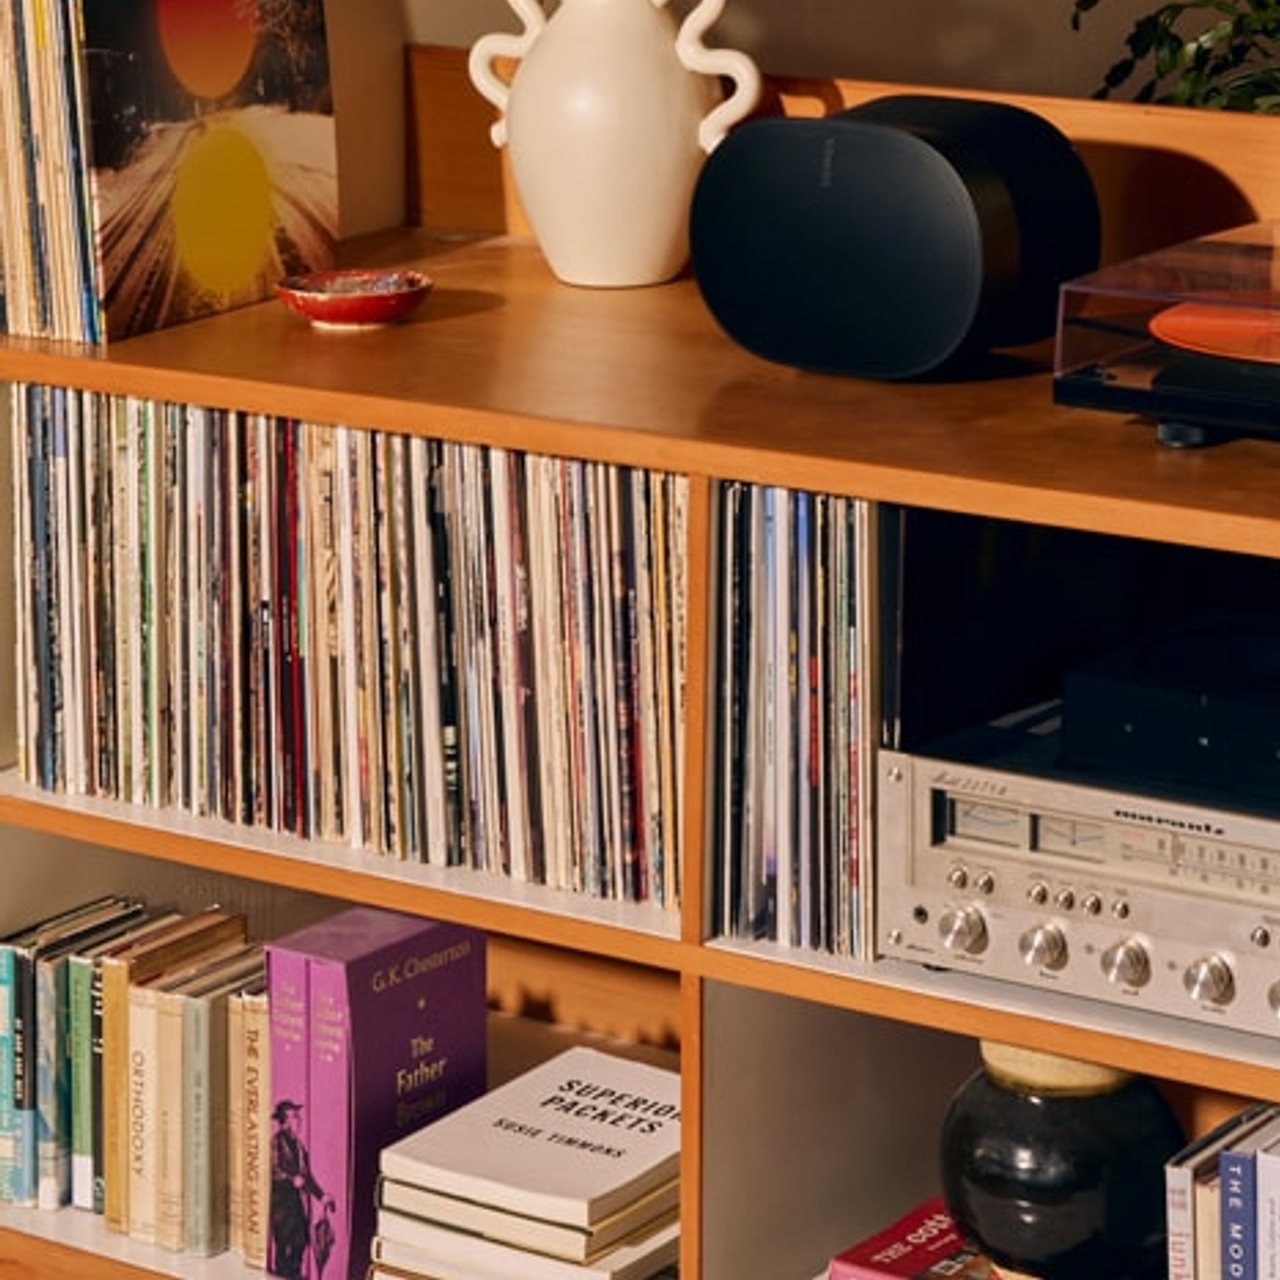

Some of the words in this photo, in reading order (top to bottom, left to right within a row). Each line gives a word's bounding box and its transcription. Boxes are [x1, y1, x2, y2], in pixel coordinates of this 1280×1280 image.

[403, 941, 472, 979] Chesterton
[246, 1028, 260, 1060] THE
[410, 1035, 436, 1060] The
[396, 1058, 448, 1097] Father
[131, 1050, 146, 1177] ORTHODOXY
[246, 1065, 260, 1183] EVERLASTING
[540, 1094, 664, 1135] PACKETS
[492, 1117, 544, 1140] SUSIE
[546, 1132, 629, 1160] TIMMONS
[1229, 1164, 1243, 1210] THE
[246, 1187, 260, 1236] MAN
